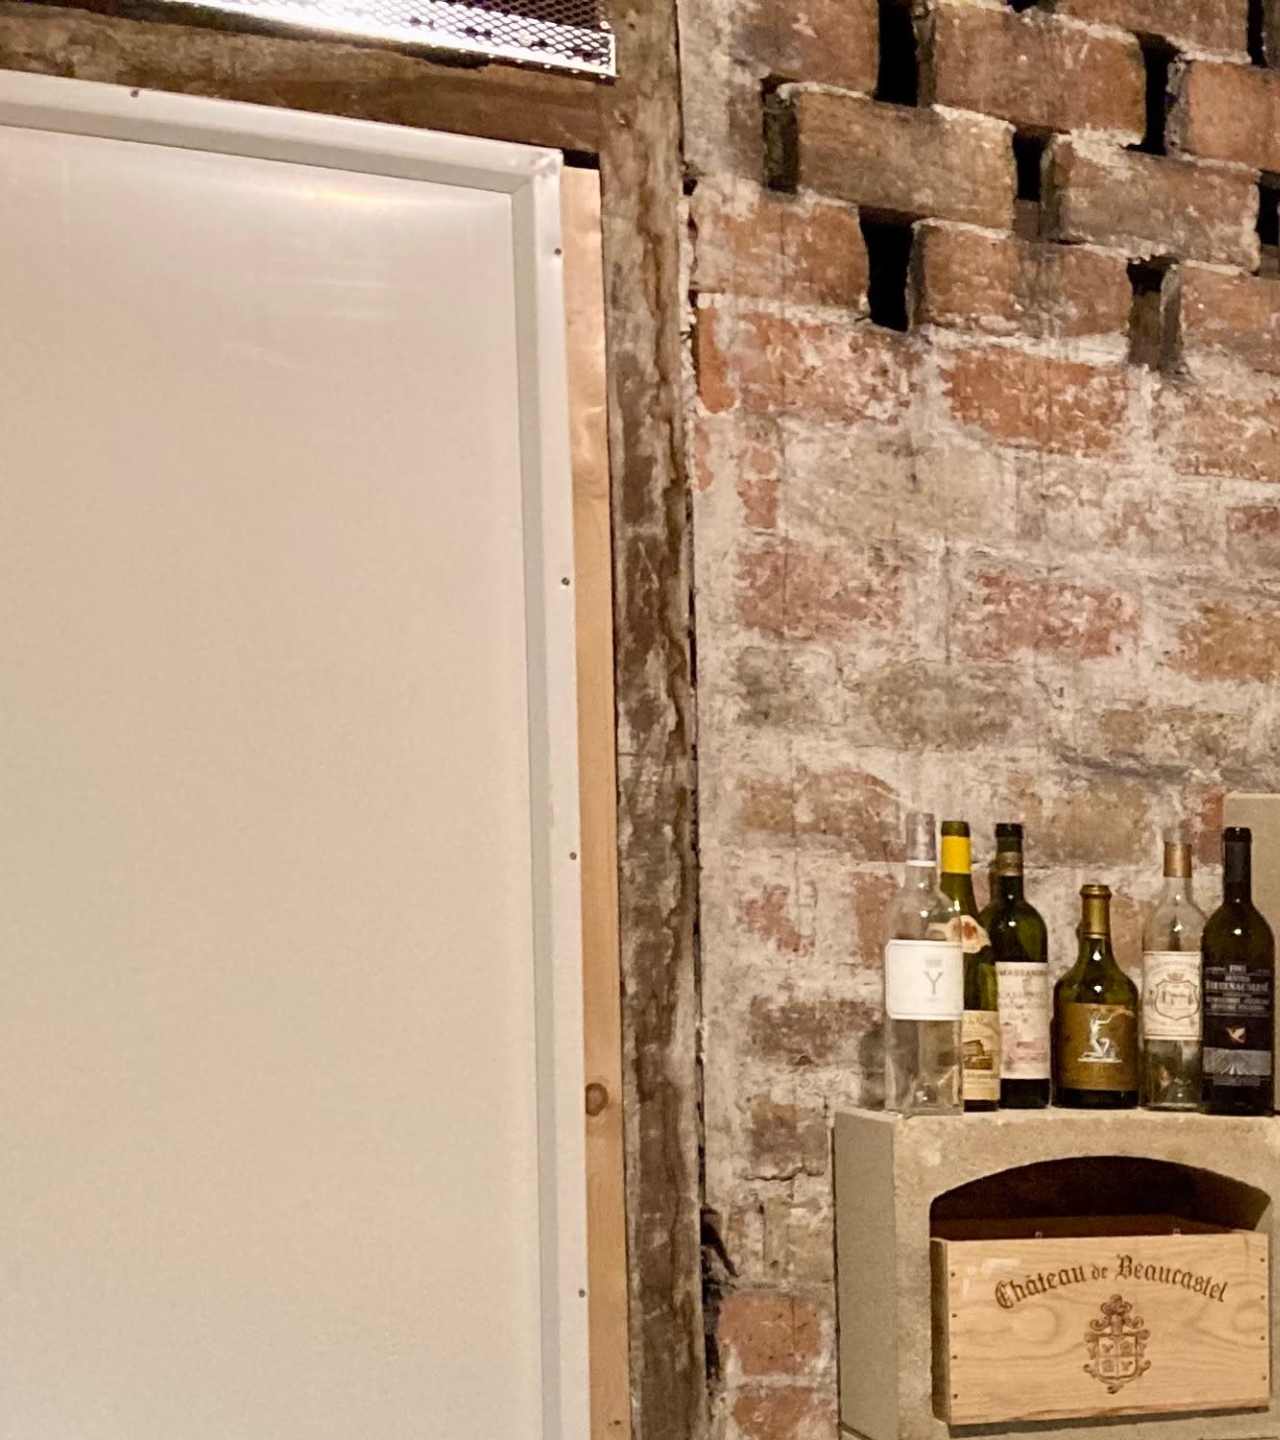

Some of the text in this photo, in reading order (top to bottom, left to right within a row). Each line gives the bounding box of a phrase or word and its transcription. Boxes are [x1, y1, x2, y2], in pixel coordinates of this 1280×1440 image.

[922, 970, 944, 996] Y
[994, 1253, 1229, 1310] Château de Beaucastel
